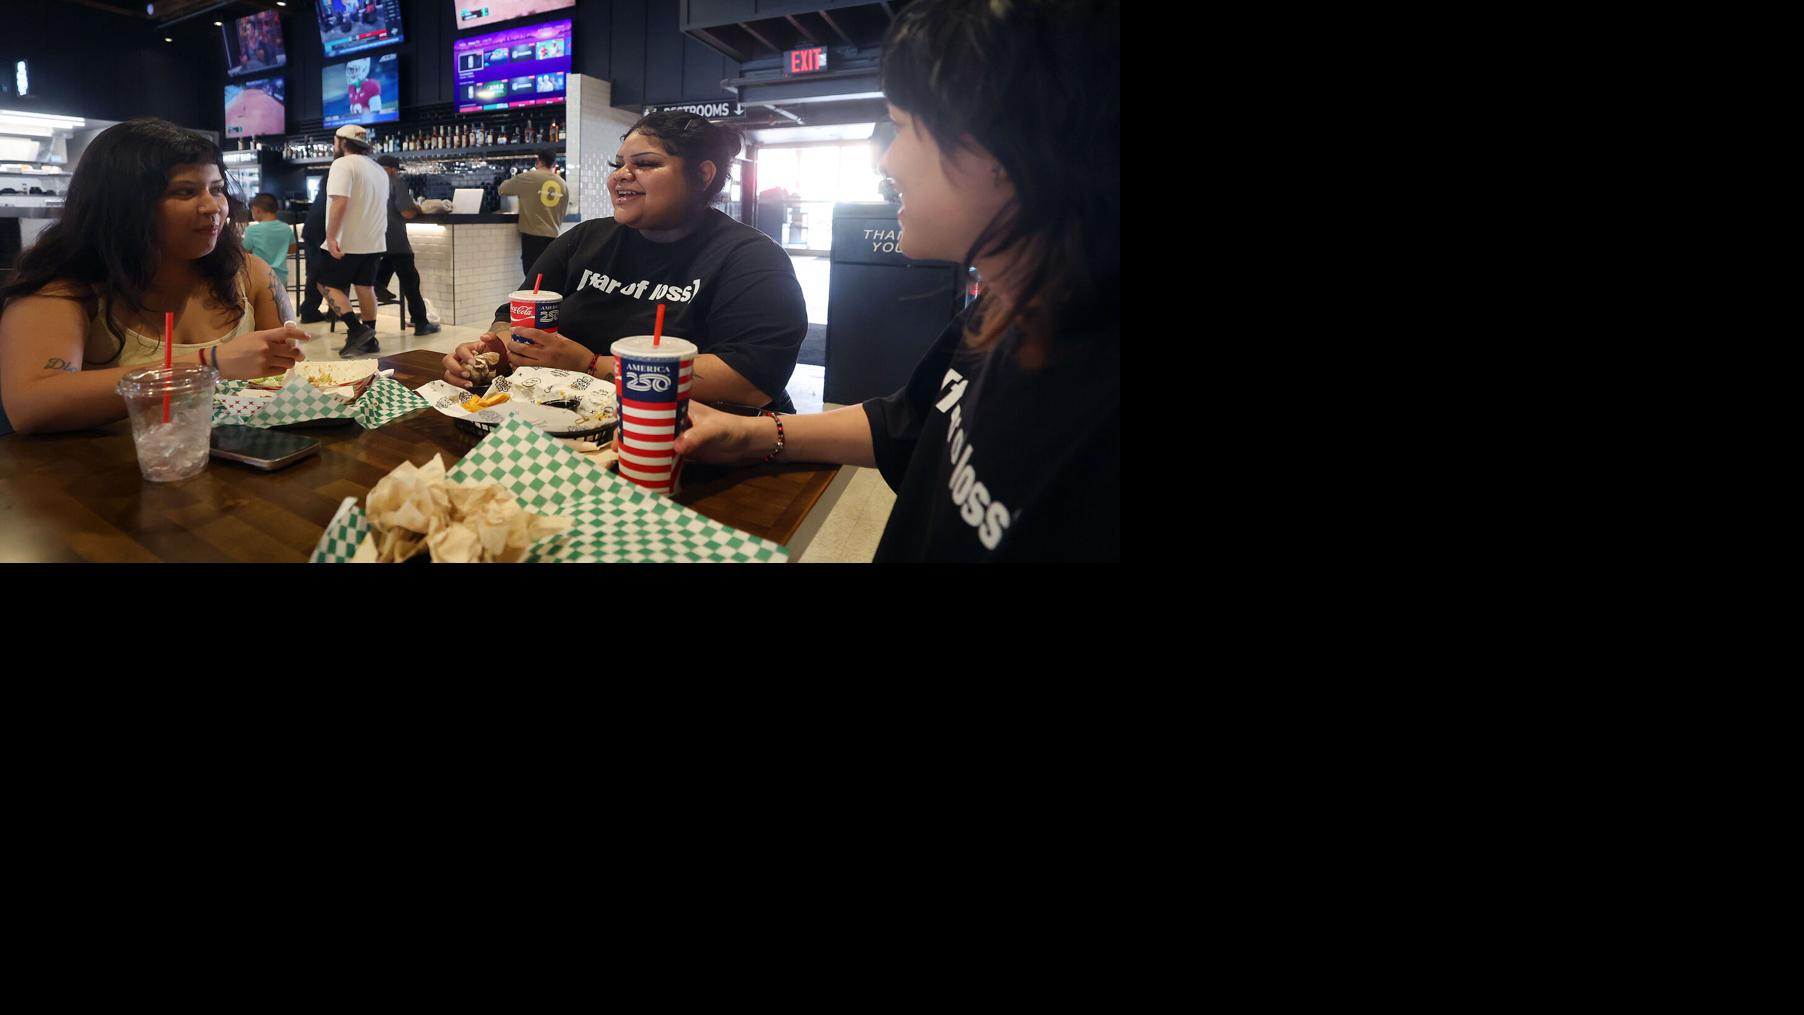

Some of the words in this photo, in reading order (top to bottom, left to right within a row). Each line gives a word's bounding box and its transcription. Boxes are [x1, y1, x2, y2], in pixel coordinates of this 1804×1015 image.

[791, 48, 822, 73] EXIT
[626, 363, 671, 374] AMERICA
[626, 371, 672, 393] 250
